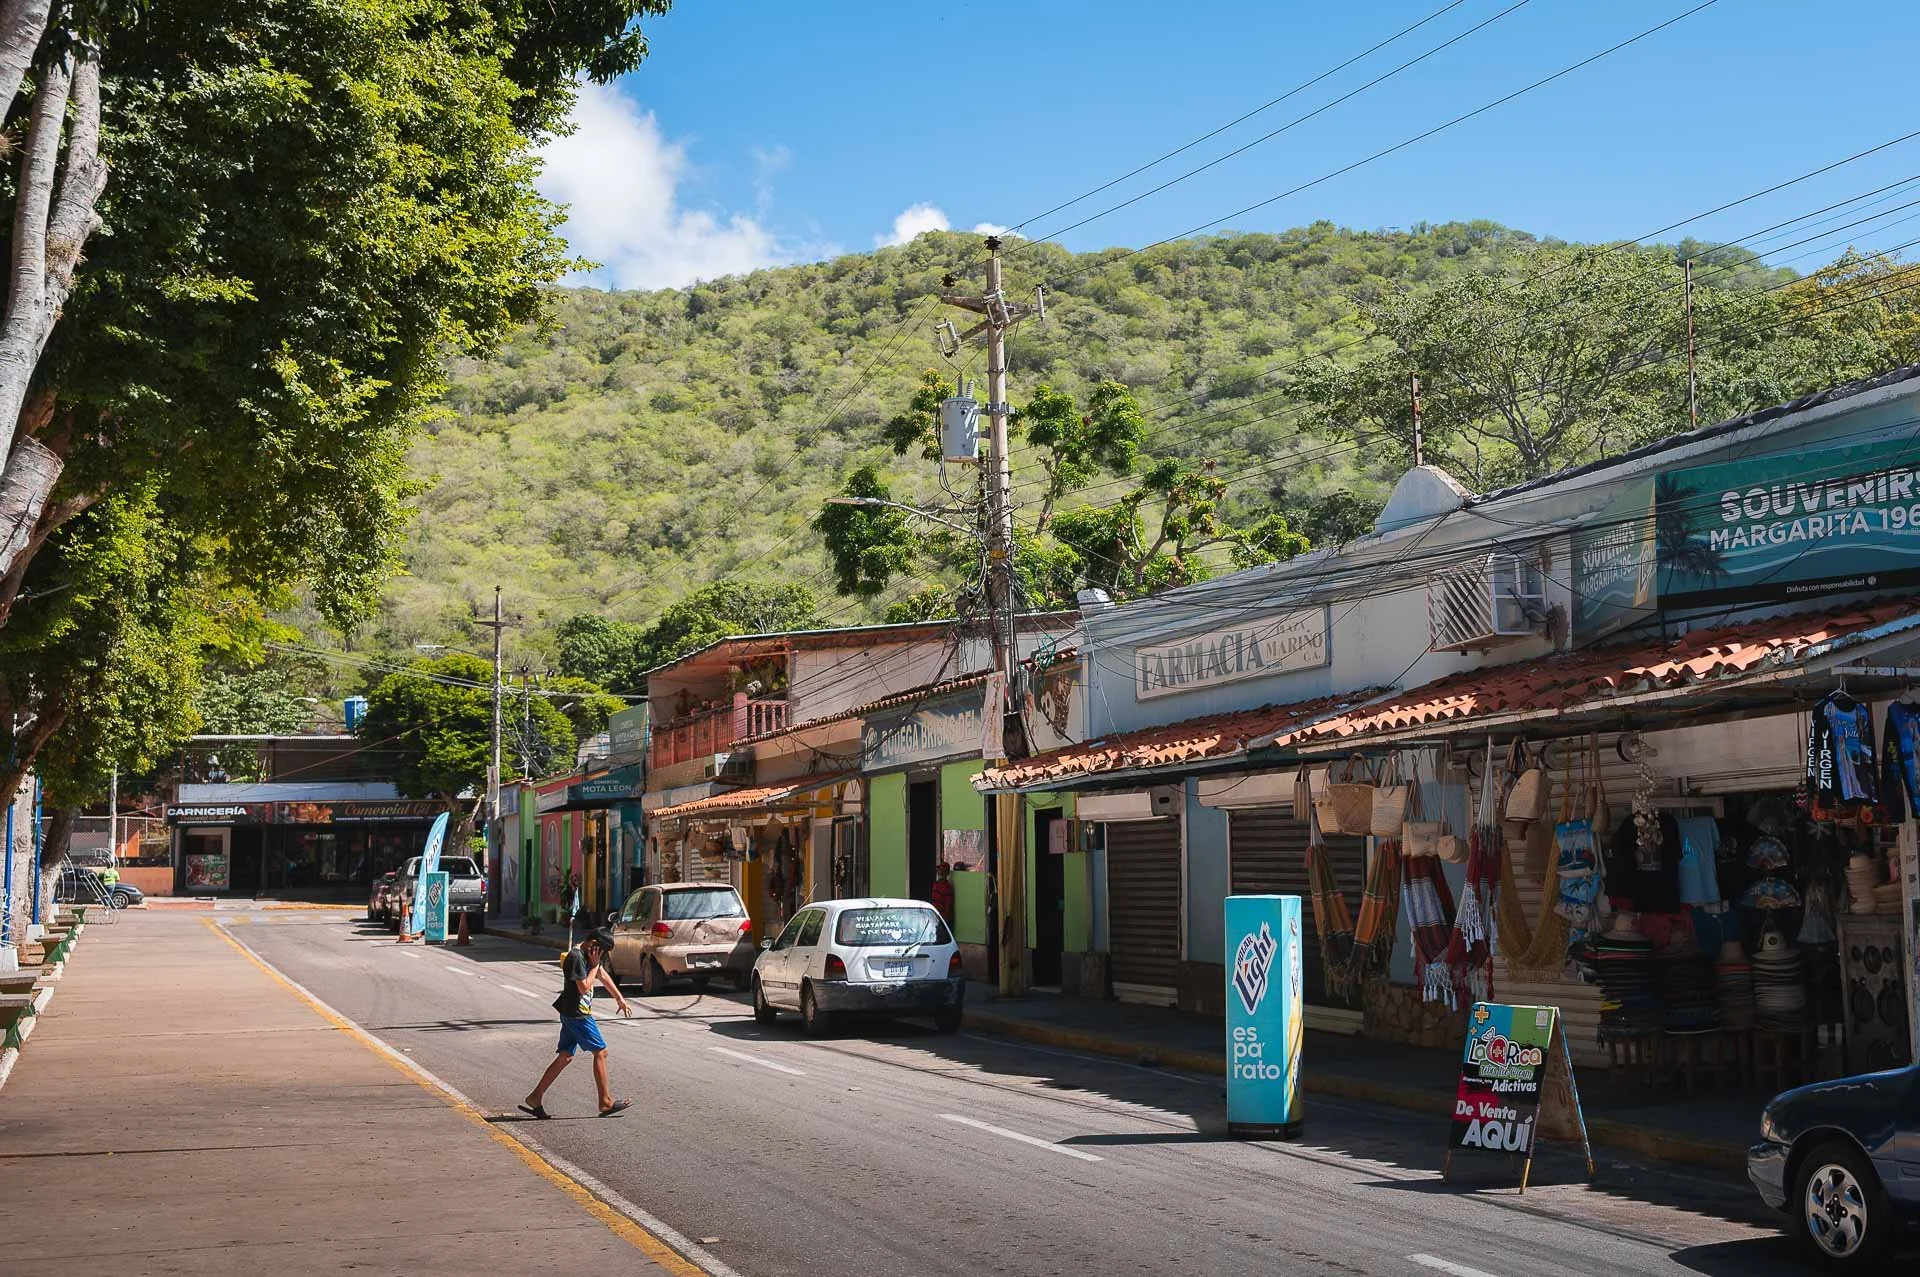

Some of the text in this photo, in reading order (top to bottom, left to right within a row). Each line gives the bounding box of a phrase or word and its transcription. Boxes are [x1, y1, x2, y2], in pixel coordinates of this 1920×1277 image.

[1721, 468, 1920, 522] SOUVENIR
[1710, 512, 1870, 551] MARGARITA
[1582, 521, 1635, 575] SOUVENIRS
[1580, 562, 1618, 600] MARGARITA
[1786, 585, 1808, 593] Disfruta
[1820, 578, 1865, 592] responsabilidad
[1276, 621, 1305, 634] PLAZA
[1266, 628, 1322, 657] MARIÑO
[1303, 651, 1321, 663] C.A.
[1141, 629, 1265, 692] FARMACIA
[882, 724, 919, 757] BODEGA
[958, 709, 976, 738] DEL
[1820, 729, 1832, 789] VIRGEN
[167, 806, 247, 816] CARNICERÍA
[344, 803, 409, 816] Comercial
[1237, 936, 1254, 966] POLAR
[1235, 929, 1274, 1011] Light
[1233, 1026, 1257, 1041] es
[1468, 1038, 1542, 1066] La Rica
[1234, 1060, 1280, 1080] rato
[1491, 1079, 1537, 1092] Adictivas
[1456, 1100, 1516, 1120] De Venta
[1461, 1115, 1533, 1152] AQUÍ
